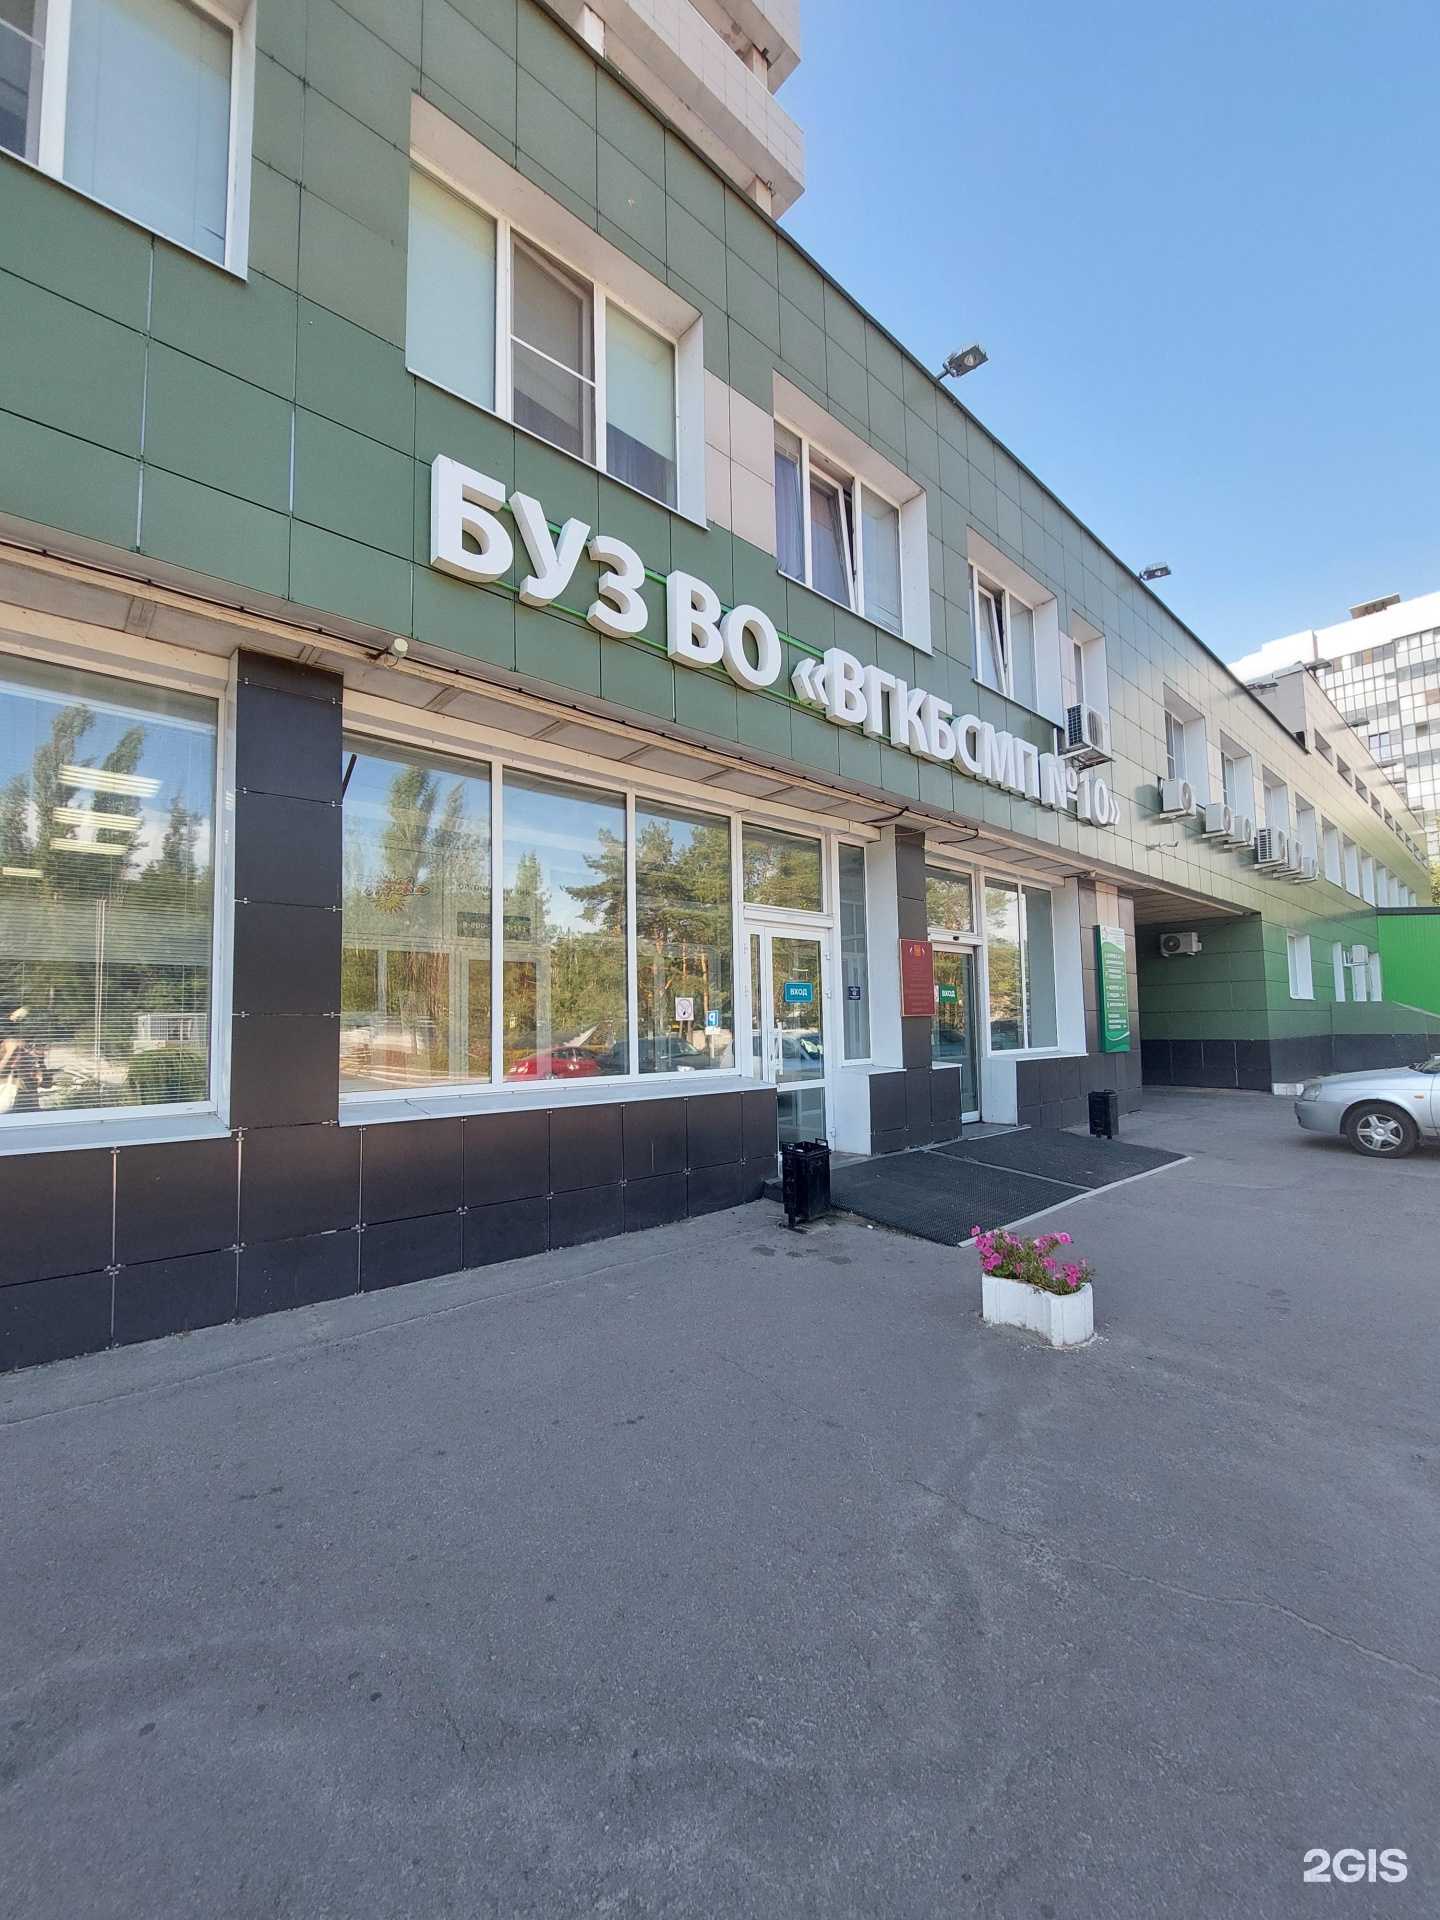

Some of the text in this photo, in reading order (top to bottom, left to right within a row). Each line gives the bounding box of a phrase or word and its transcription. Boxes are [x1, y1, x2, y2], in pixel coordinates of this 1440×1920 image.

[430, 454, 648, 639] БУЗ
[667, 569, 782, 691] ВО
[791, 647, 1040, 799] «ВГКБСМП
[789, 987, 808, 997] ВХОД
